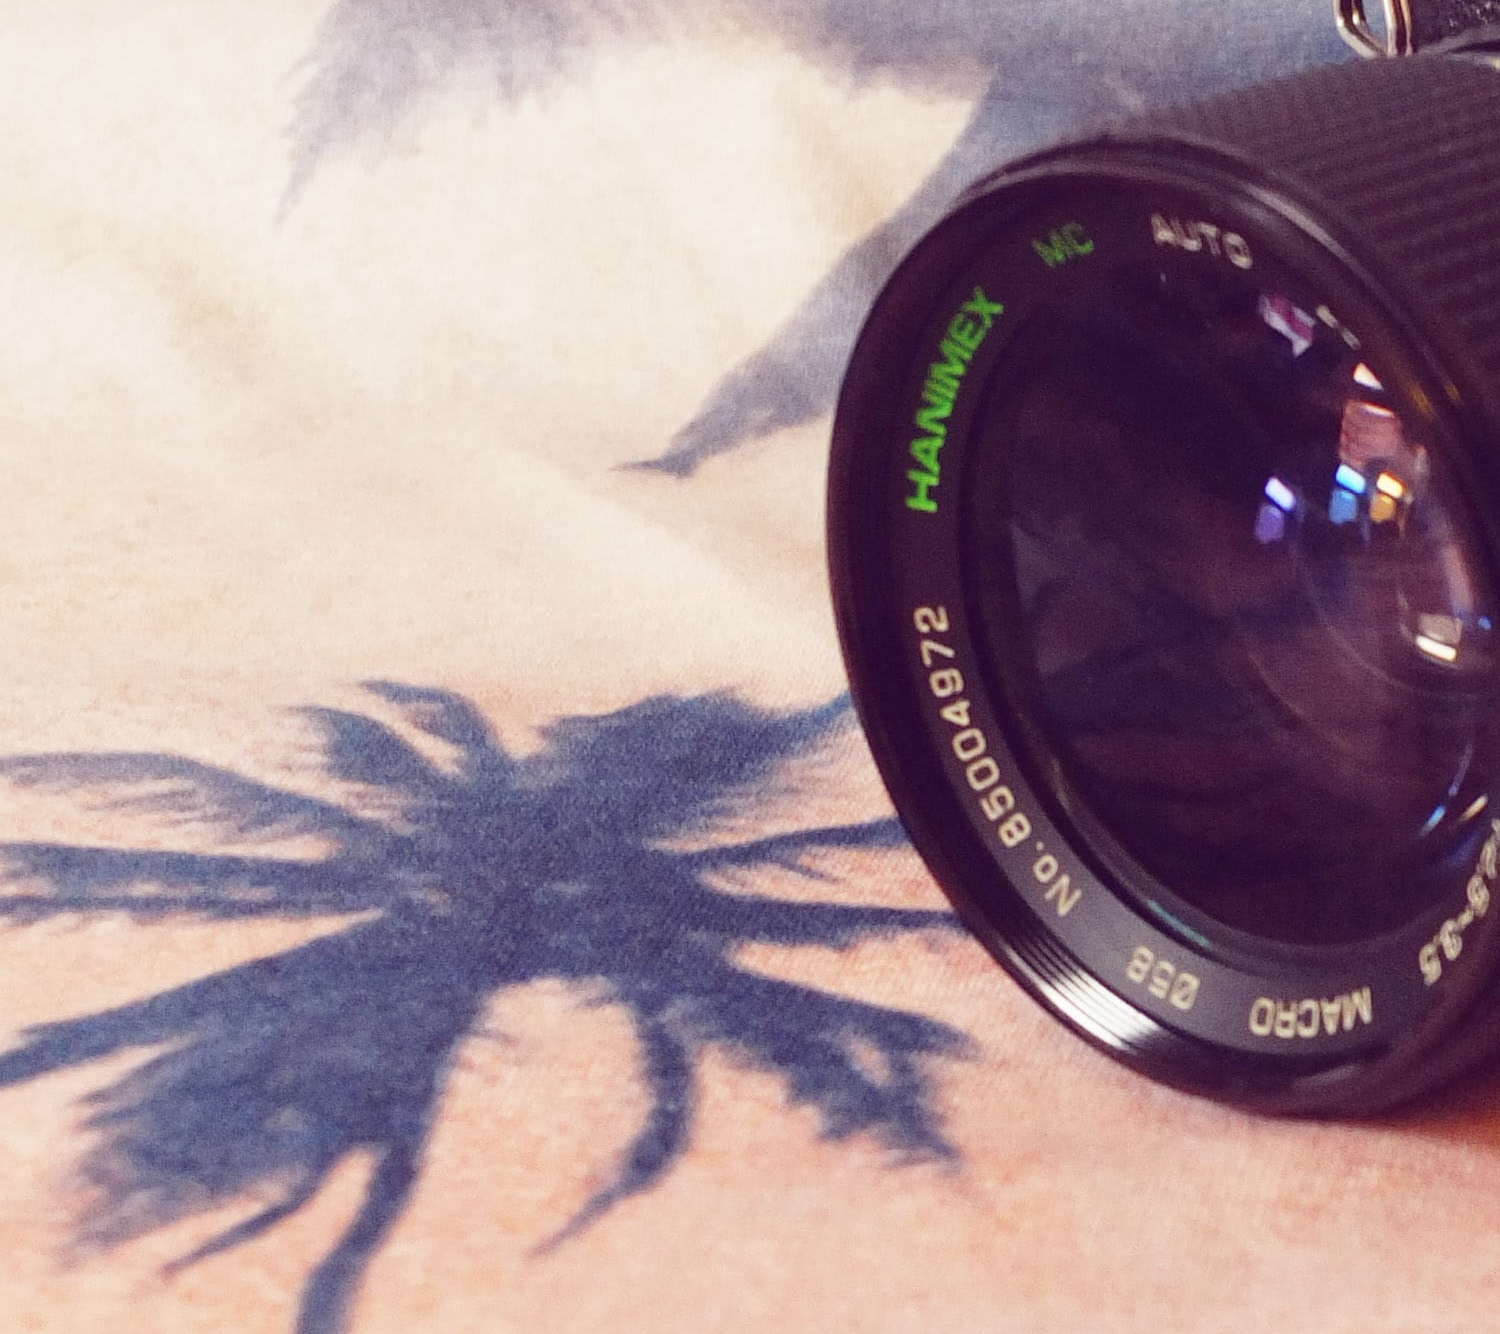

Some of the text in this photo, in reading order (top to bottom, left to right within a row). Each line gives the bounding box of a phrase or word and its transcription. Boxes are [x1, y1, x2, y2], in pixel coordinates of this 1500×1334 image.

[1031, 219, 1095, 267] MC
[1150, 213, 1255, 270] AUTO
[905, 284, 1006, 513] HANIMEX
[1247, 984, 1374, 1040] MACRO
